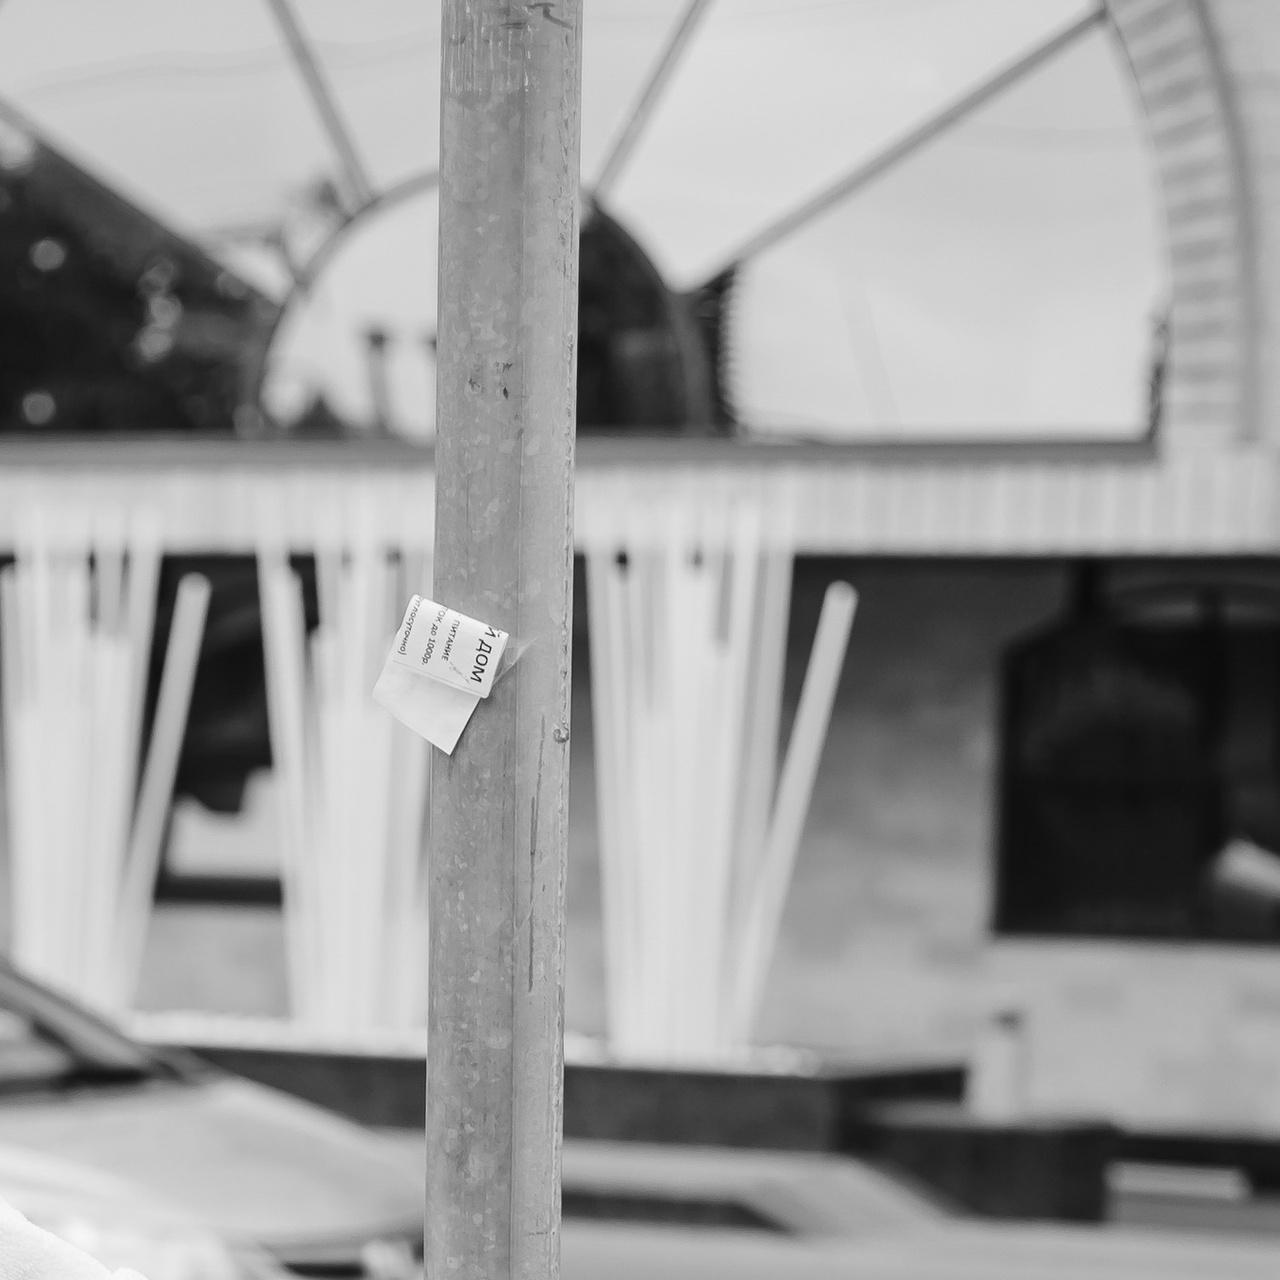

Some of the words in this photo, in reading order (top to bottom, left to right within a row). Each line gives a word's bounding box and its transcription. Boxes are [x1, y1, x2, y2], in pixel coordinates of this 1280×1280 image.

[431, 623, 439, 636] до
[441, 619, 460, 661] ПИТАНИЕ
[421, 637, 436, 665] 1000р.
[470, 638, 492, 683] ДОМ
